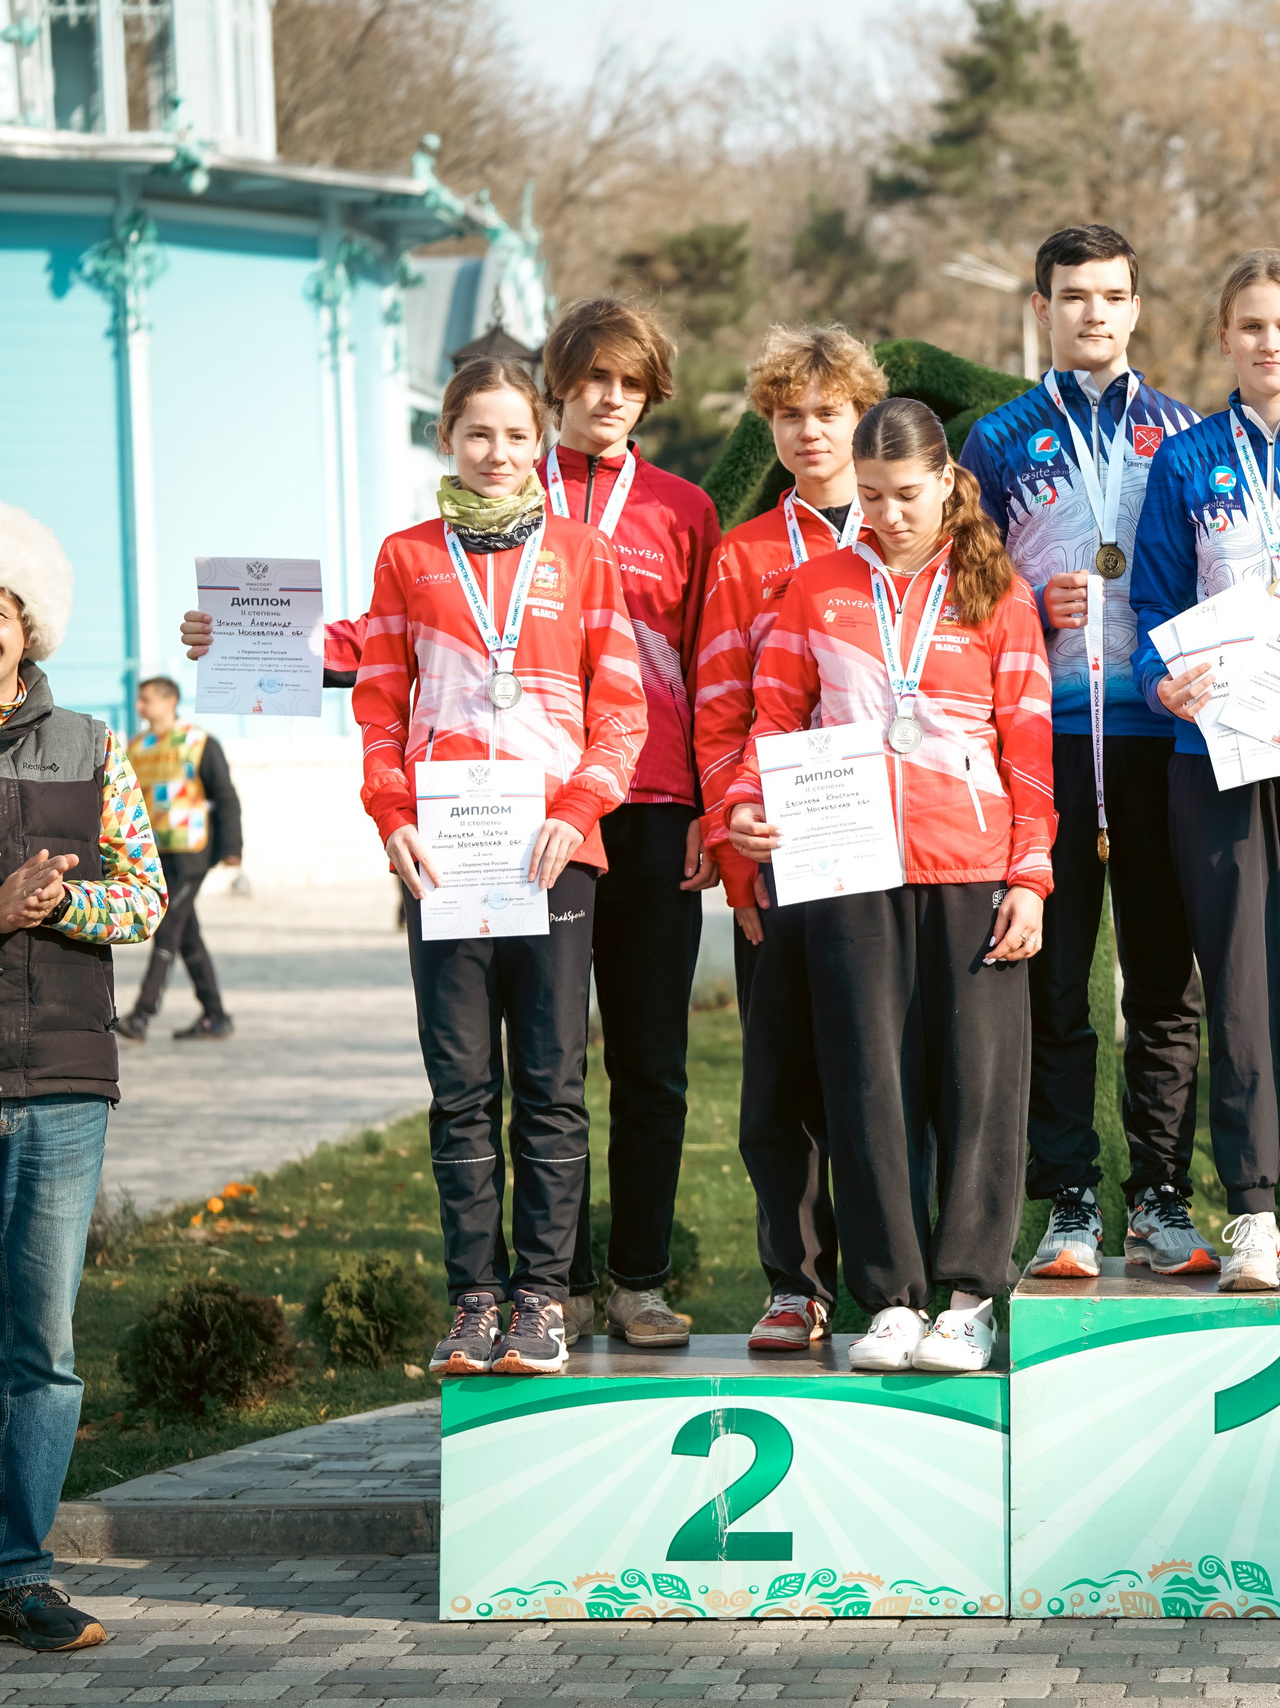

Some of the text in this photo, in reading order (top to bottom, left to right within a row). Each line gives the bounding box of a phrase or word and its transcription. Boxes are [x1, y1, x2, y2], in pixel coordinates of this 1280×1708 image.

[1035, 494, 1048, 503] SFR
[1241, 444, 1274, 535] МИНИСТЕРСТВО СПОРТА РОССИИ
[628, 563, 662, 581] Фрязино
[451, 541, 489, 630] МИНИСТЕРСТВО СПОРТА РОССИИ
[230, 597, 291, 607] ДИПЛОМ
[511, 581, 525, 626] МИНИСТЕРСТВО
[913, 630, 928, 673] МИНИСТЕРСТВО
[932, 584, 943, 607] РОССИИ
[1210, 692, 1230, 700] оманда
[22, 762, 50, 772] RedFox
[795, 767, 854, 786] ДИПЛОМ
[812, 783, 846, 792] степень
[450, 805, 512, 818] ДИПЛОМ
[666, 1407, 794, 1562] 2
